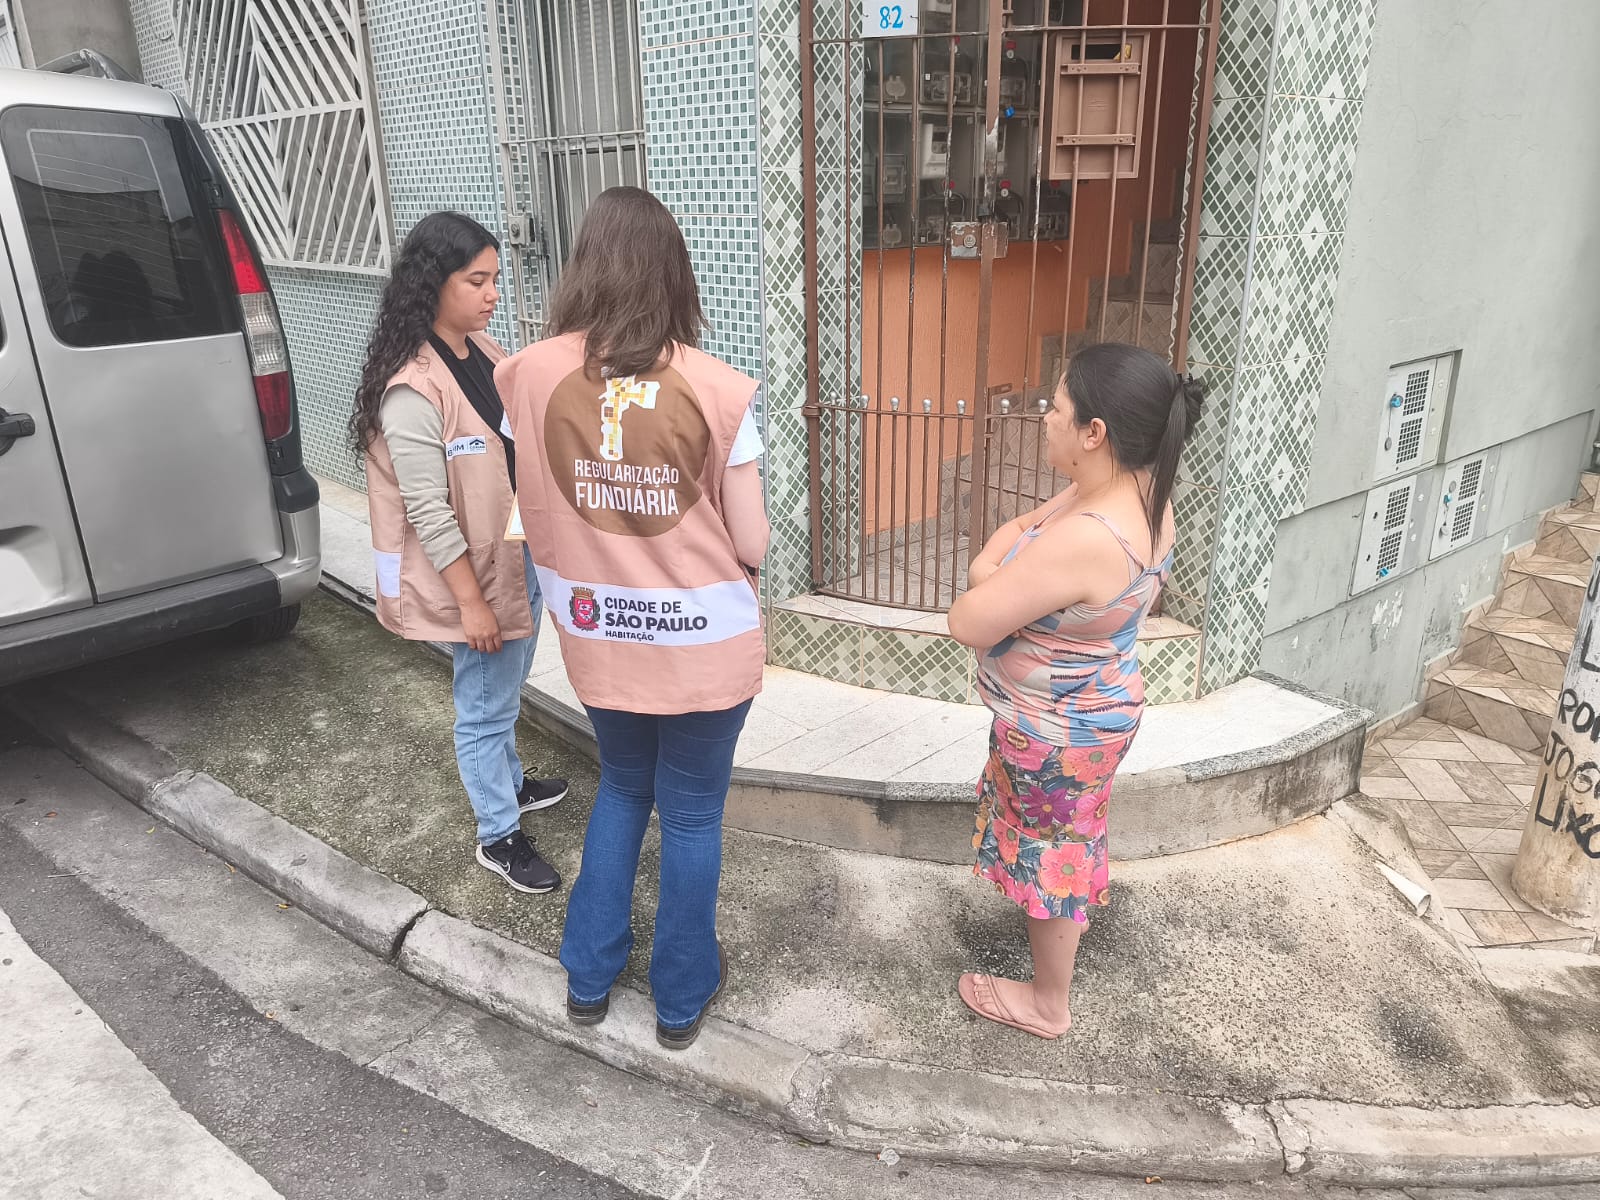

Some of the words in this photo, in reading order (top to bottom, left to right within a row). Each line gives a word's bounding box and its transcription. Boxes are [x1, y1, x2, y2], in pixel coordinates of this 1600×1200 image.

[879, 5, 904, 29] 82
[574, 459, 680, 488] REGULARIZAÇÃO
[575, 482, 680, 516] FUNDIÁRIA
[604, 596, 657, 614] CIDADE
[661, 601, 682, 614] DE
[605, 610, 642, 628] SÃO
[646, 616, 708, 632] PAULO
[605, 630, 655, 641] HABITAÇÃO
